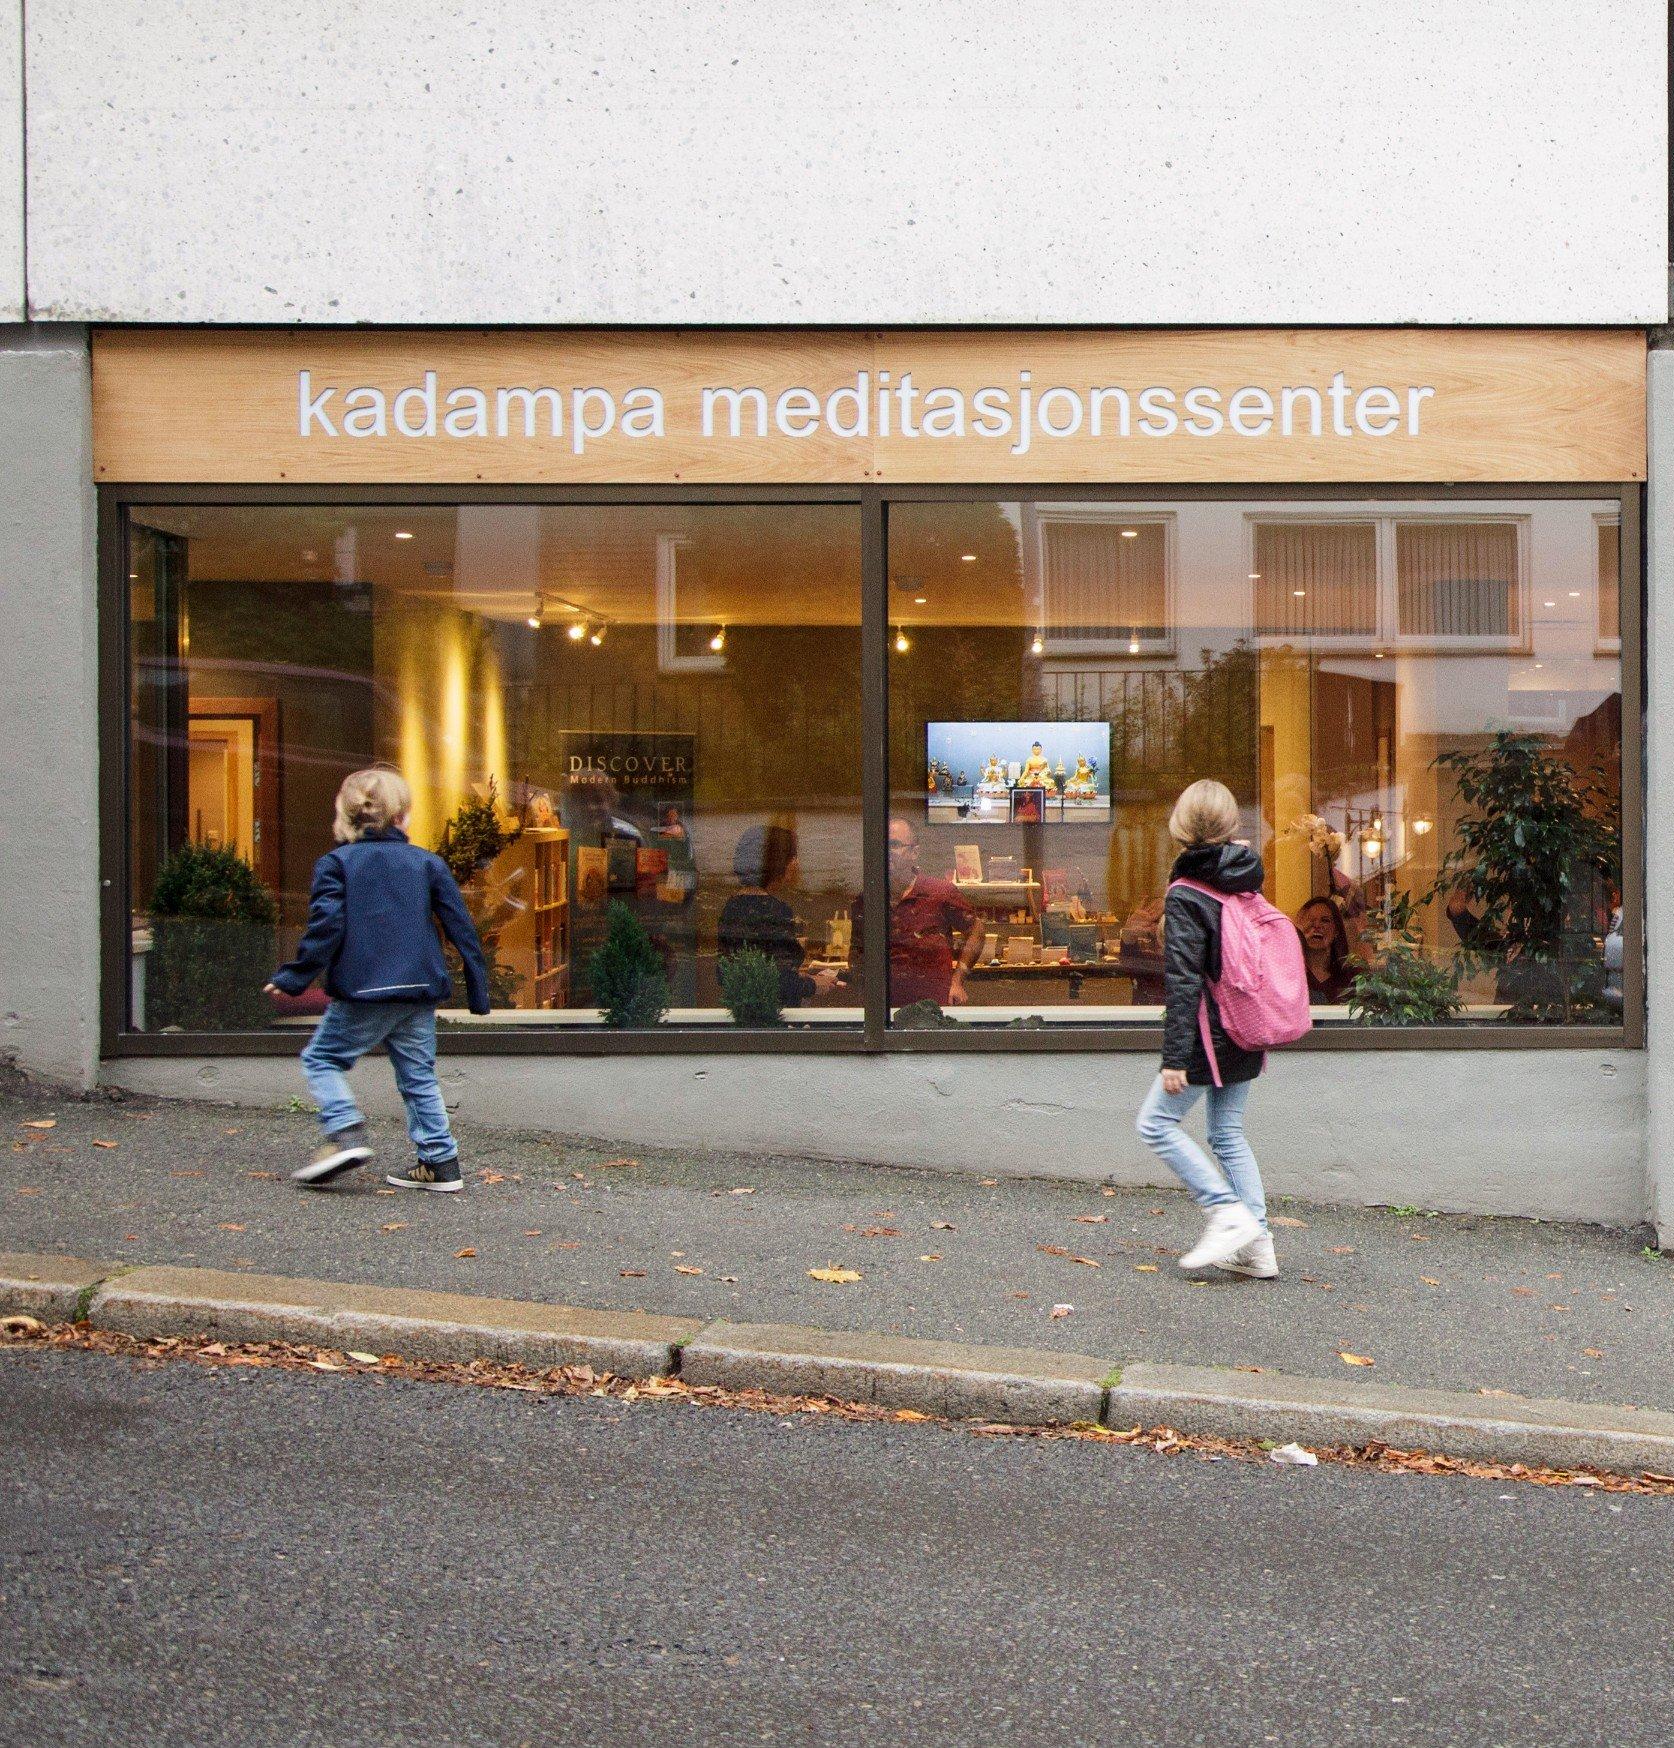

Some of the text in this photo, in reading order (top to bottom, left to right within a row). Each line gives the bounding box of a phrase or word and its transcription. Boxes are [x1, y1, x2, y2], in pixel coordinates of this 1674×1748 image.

[298, 369, 1437, 455] kadampa meditasjonssenter
[569, 755, 686, 772] DISCOVER
[570, 774, 688, 784] Modern Buddhism
